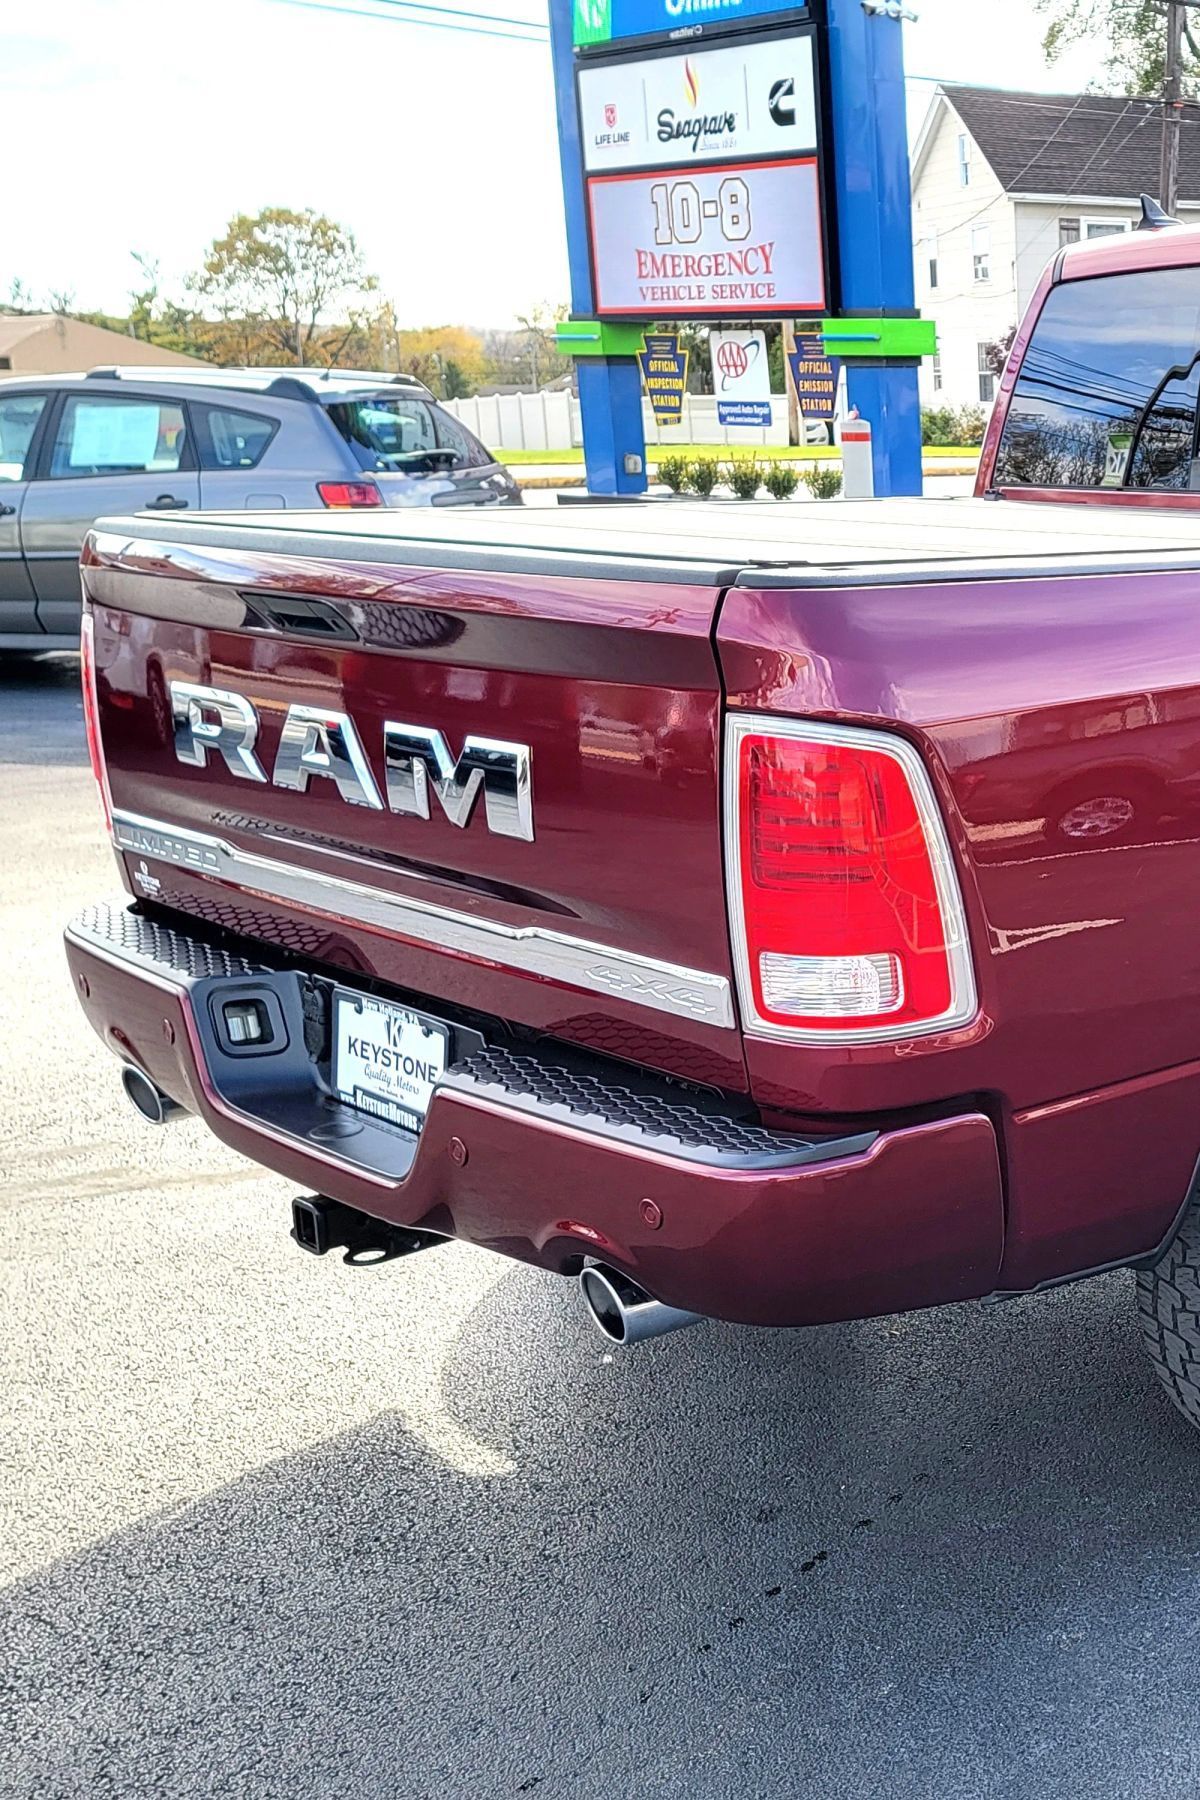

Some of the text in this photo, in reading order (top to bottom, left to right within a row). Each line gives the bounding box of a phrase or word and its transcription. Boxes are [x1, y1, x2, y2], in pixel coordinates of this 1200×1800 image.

[594, 131, 631, 145] LIFE LINE
[657, 108, 736, 152] Seagrave
[650, 177, 752, 246] 10-8
[635, 241, 775, 279] EMERGENCY
[639, 282, 777, 301] VEHICLE SERVICE
[648, 359, 680, 373] OFFICIAL
[718, 341, 748, 378] AAA
[798, 361, 833, 374] OFFICIAL
[647, 377, 685, 390] INSPECTION
[798, 379, 834, 393] EMISSION
[652, 394, 681, 408] STATION
[801, 397, 833, 412] STATION
[170, 679, 536, 843] RAM
[115, 824, 221, 873] LIMITED
[347, 1034, 438, 1085] KEYSTONE
[364, 1063, 392, 1088] Quality
